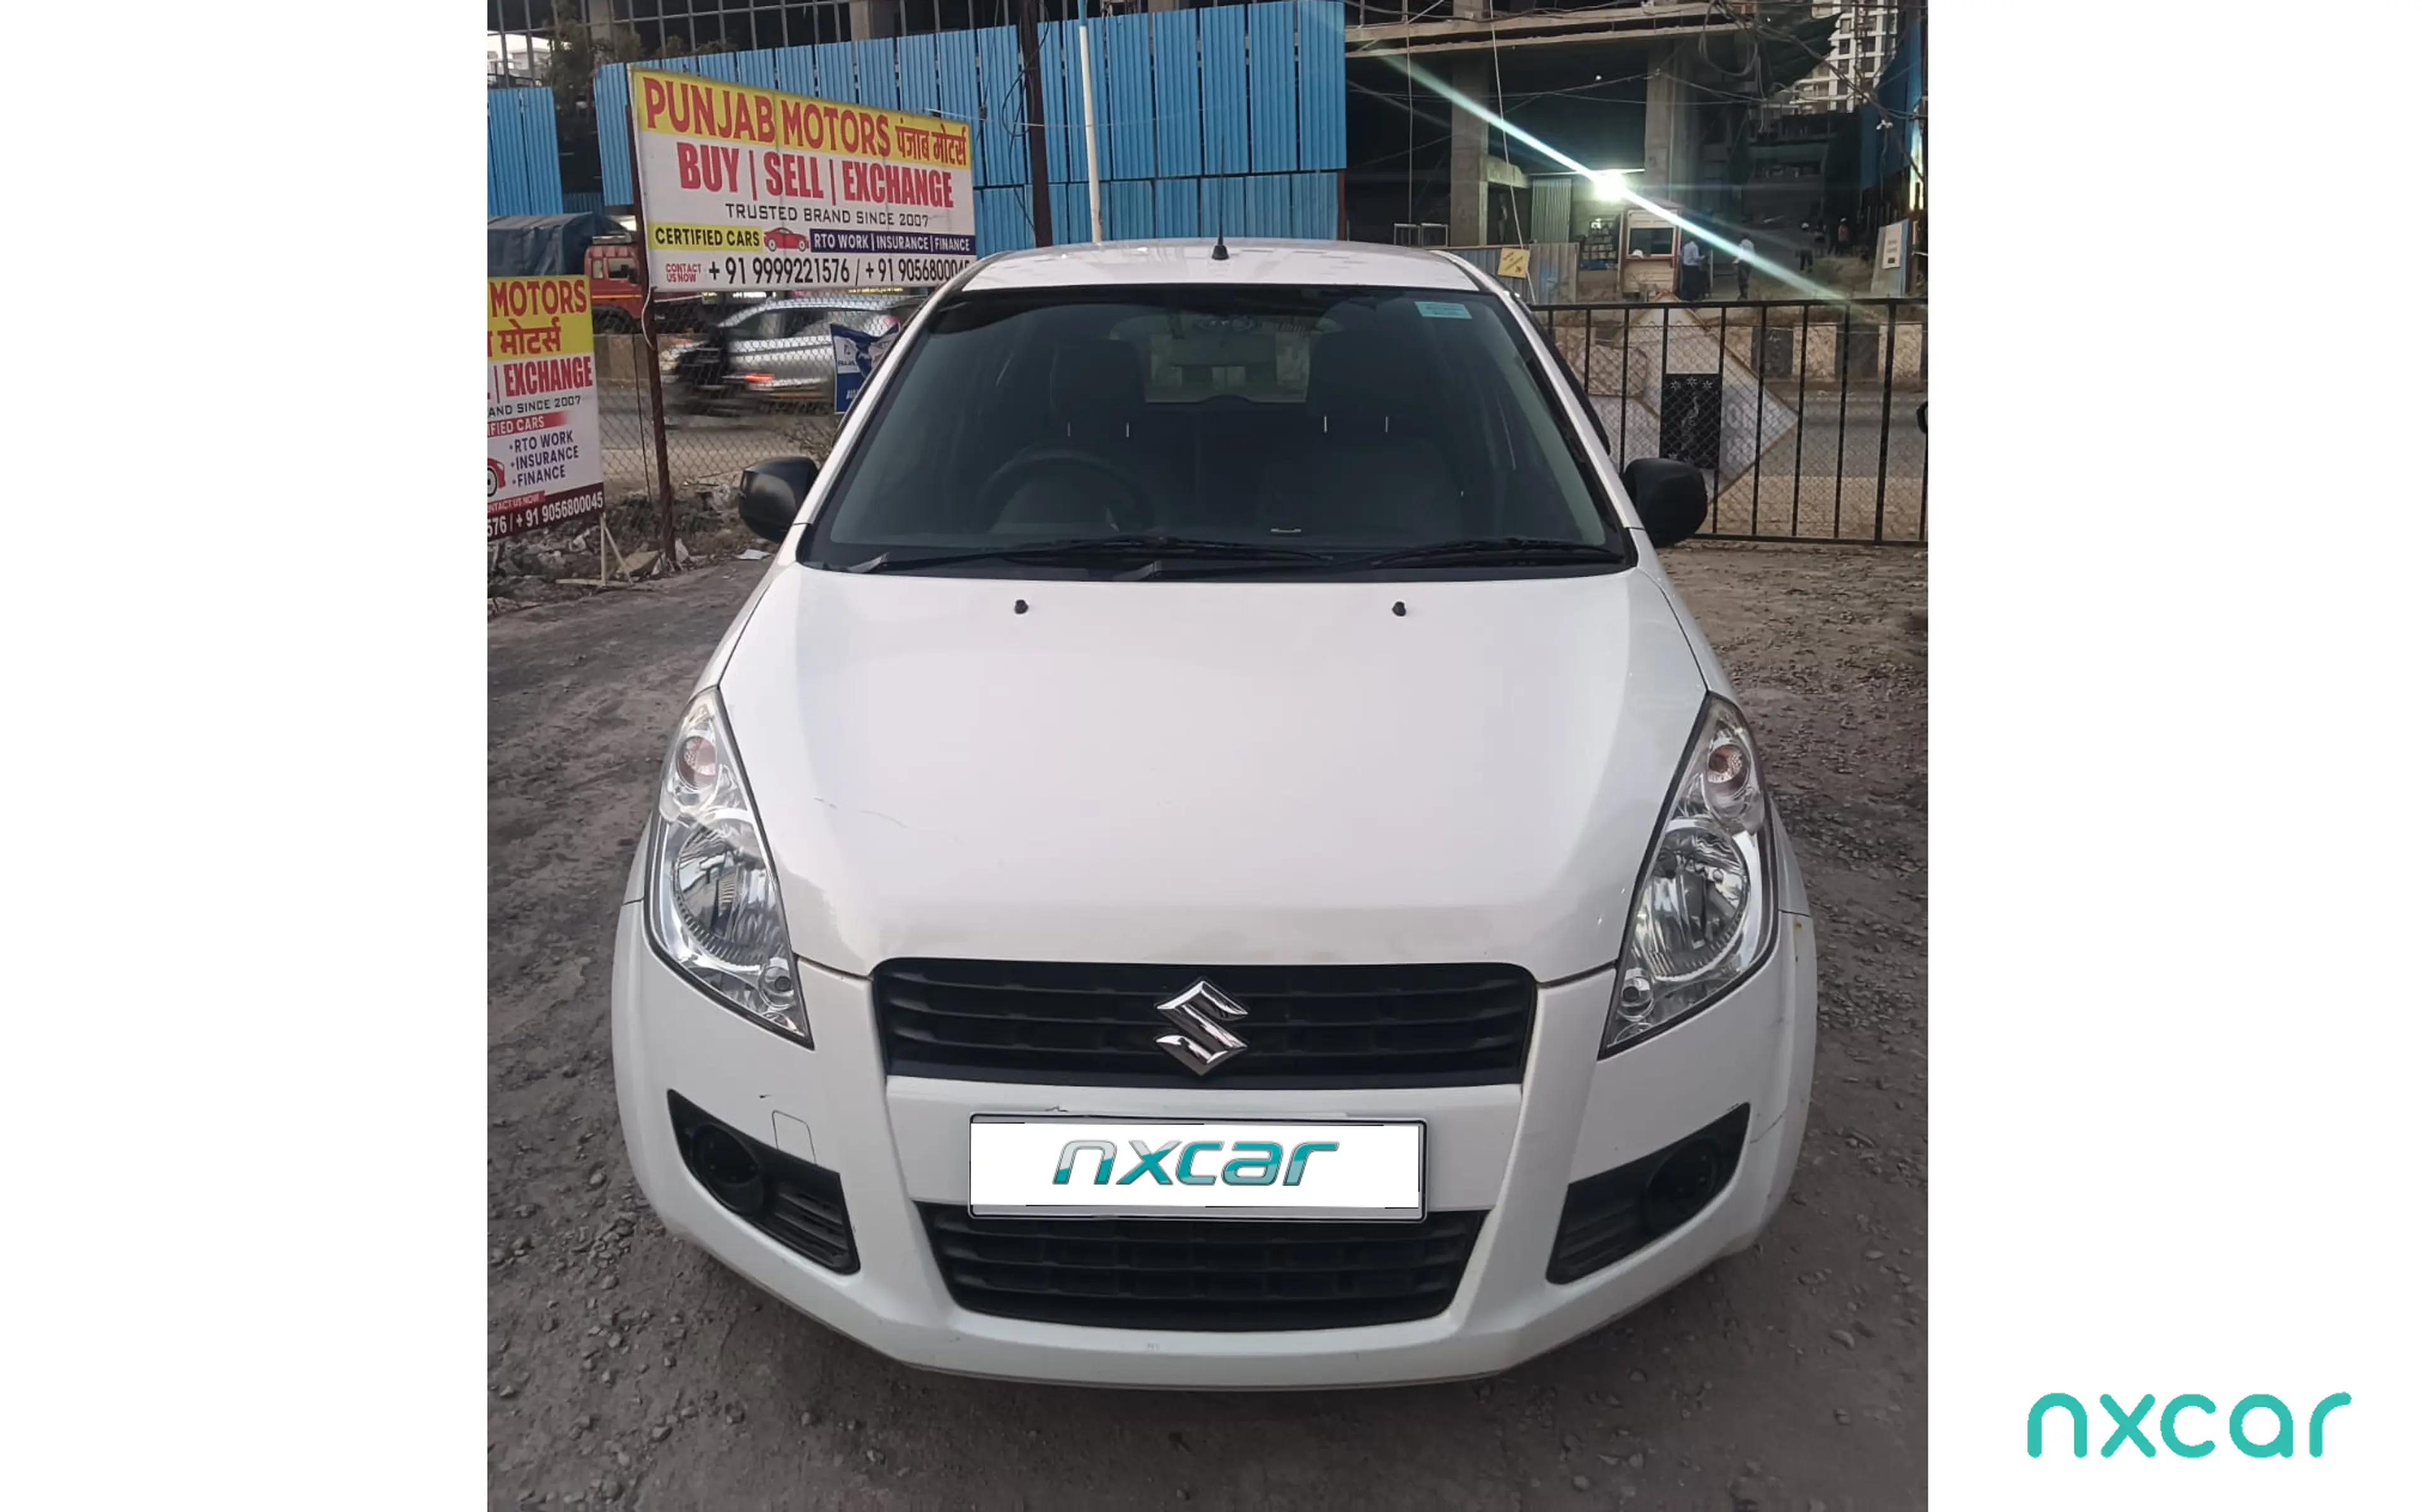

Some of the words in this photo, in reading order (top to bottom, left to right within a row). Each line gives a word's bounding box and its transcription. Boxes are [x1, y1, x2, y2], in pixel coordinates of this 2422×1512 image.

[643, 77, 776, 144] PUNJAB
[781, 100, 891, 158] MOTORS
[895, 117, 930, 161] पंजाब
[932, 122, 966, 166] मोटर्स
[677, 142, 739, 192] BUY
[764, 151, 824, 199] SELL
[841, 160, 954, 207] EXCHANGE
[726, 203, 797, 220] TRUSTED
[804, 208, 850, 224] BRAND
[857, 211, 894, 226] SINCE
[899, 213, 929, 228] 2007
[655, 228, 723, 246] CERTIFIED
[727, 231, 760, 247] CARS
[814, 233, 835, 248] RTO
[838, 234, 869, 249] WORK
[877, 235, 928, 250] INSURANCE
[935, 237, 970, 251] FINANCE
[665, 263, 701, 274] CONTACT
[667, 273, 677, 282] US
[677, 273, 696, 282] NOW
[725, 257, 746, 284] 91
[752, 257, 850, 284] 9999221576
[878, 258, 893, 282] 91
[489, 279, 587, 317] MOTORS
[497, 316, 561, 355] मोटर्स
[504, 356, 593, 397] EXCHANGE
[517, 399, 551, 413] SINCE
[554, 395, 581, 408] 2007
[517, 416, 545, 431] CARS
[515, 436, 537, 453] RTO
[540, 430, 574, 448] WORK
[516, 445, 579, 470] INSURANCE
[518, 465, 566, 487] FINANCE
[525, 507, 539, 528] 91
[542, 491, 603, 523] 9056800045
